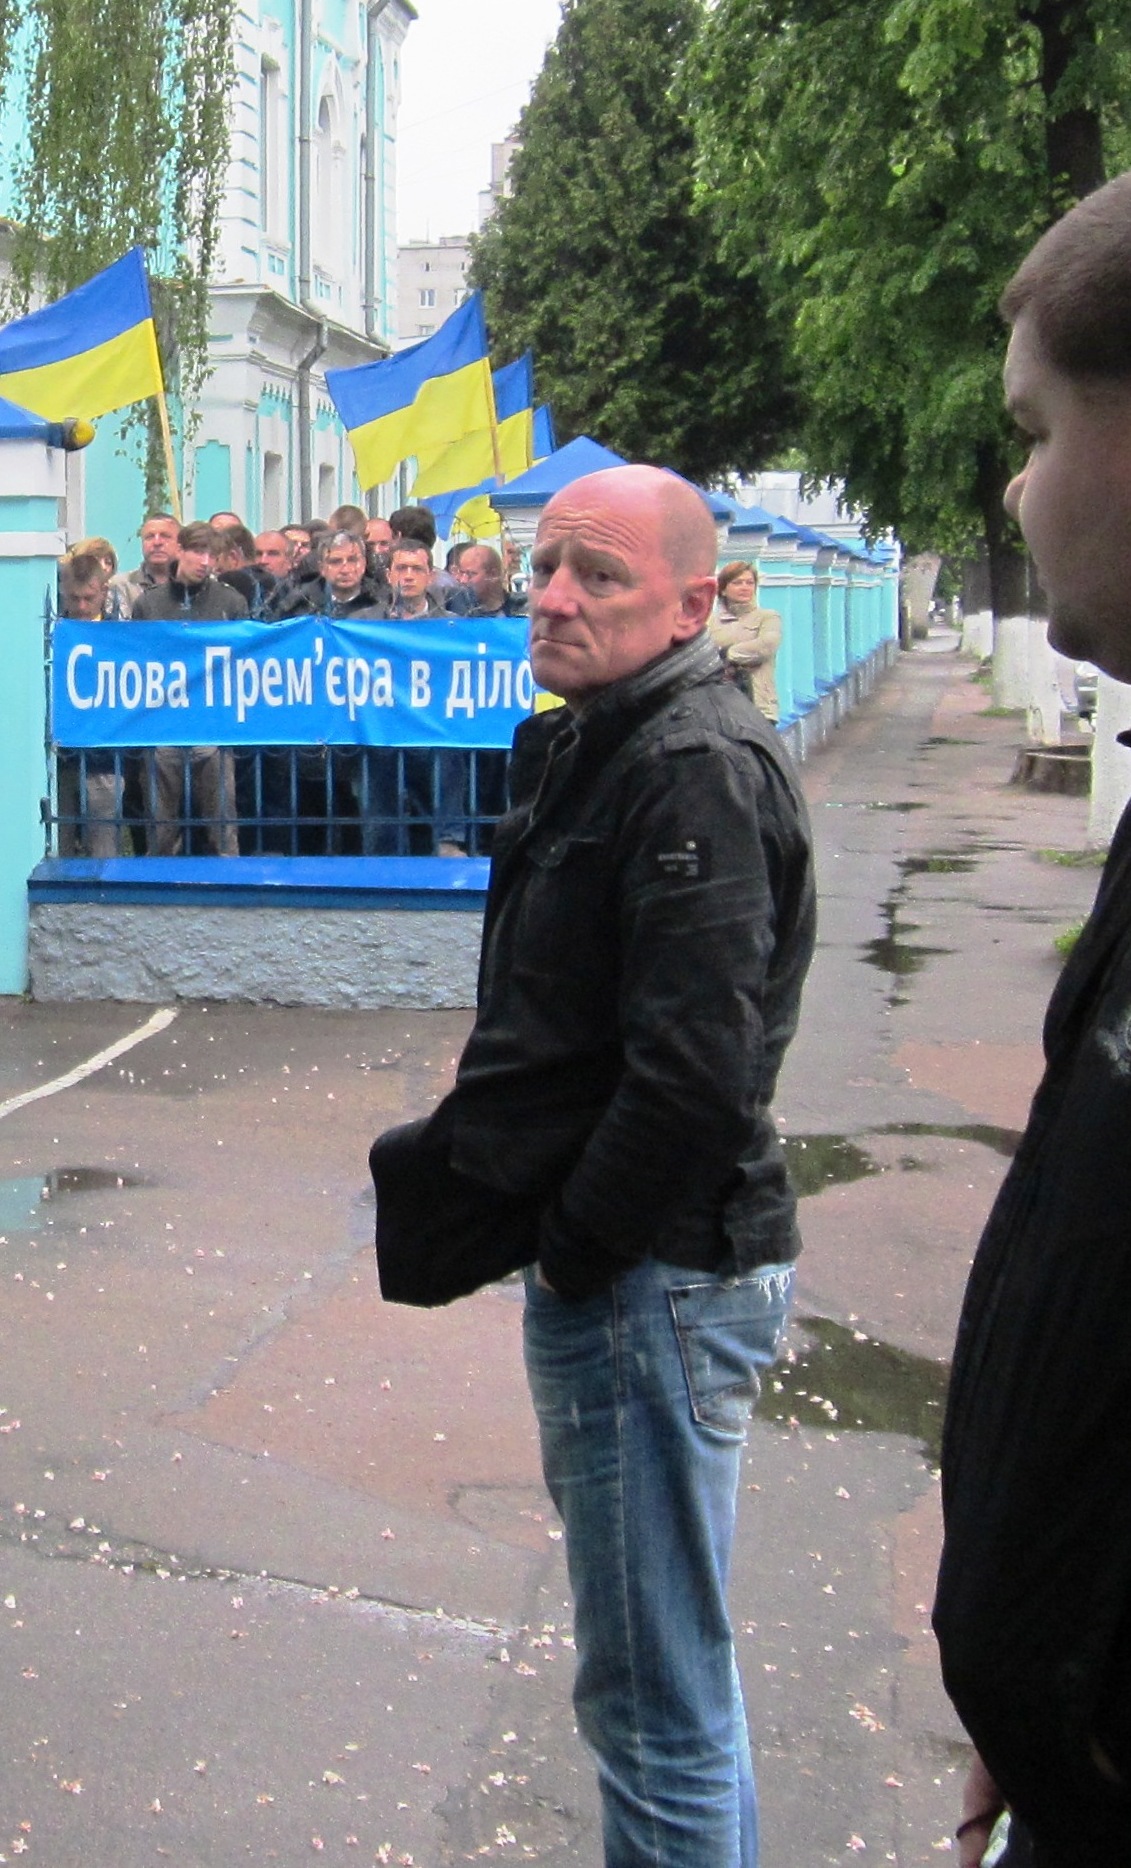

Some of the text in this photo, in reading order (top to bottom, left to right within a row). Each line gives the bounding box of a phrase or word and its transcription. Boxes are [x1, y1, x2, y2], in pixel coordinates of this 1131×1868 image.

[66, 637, 533, 722] Слова Прем'єра в діло
